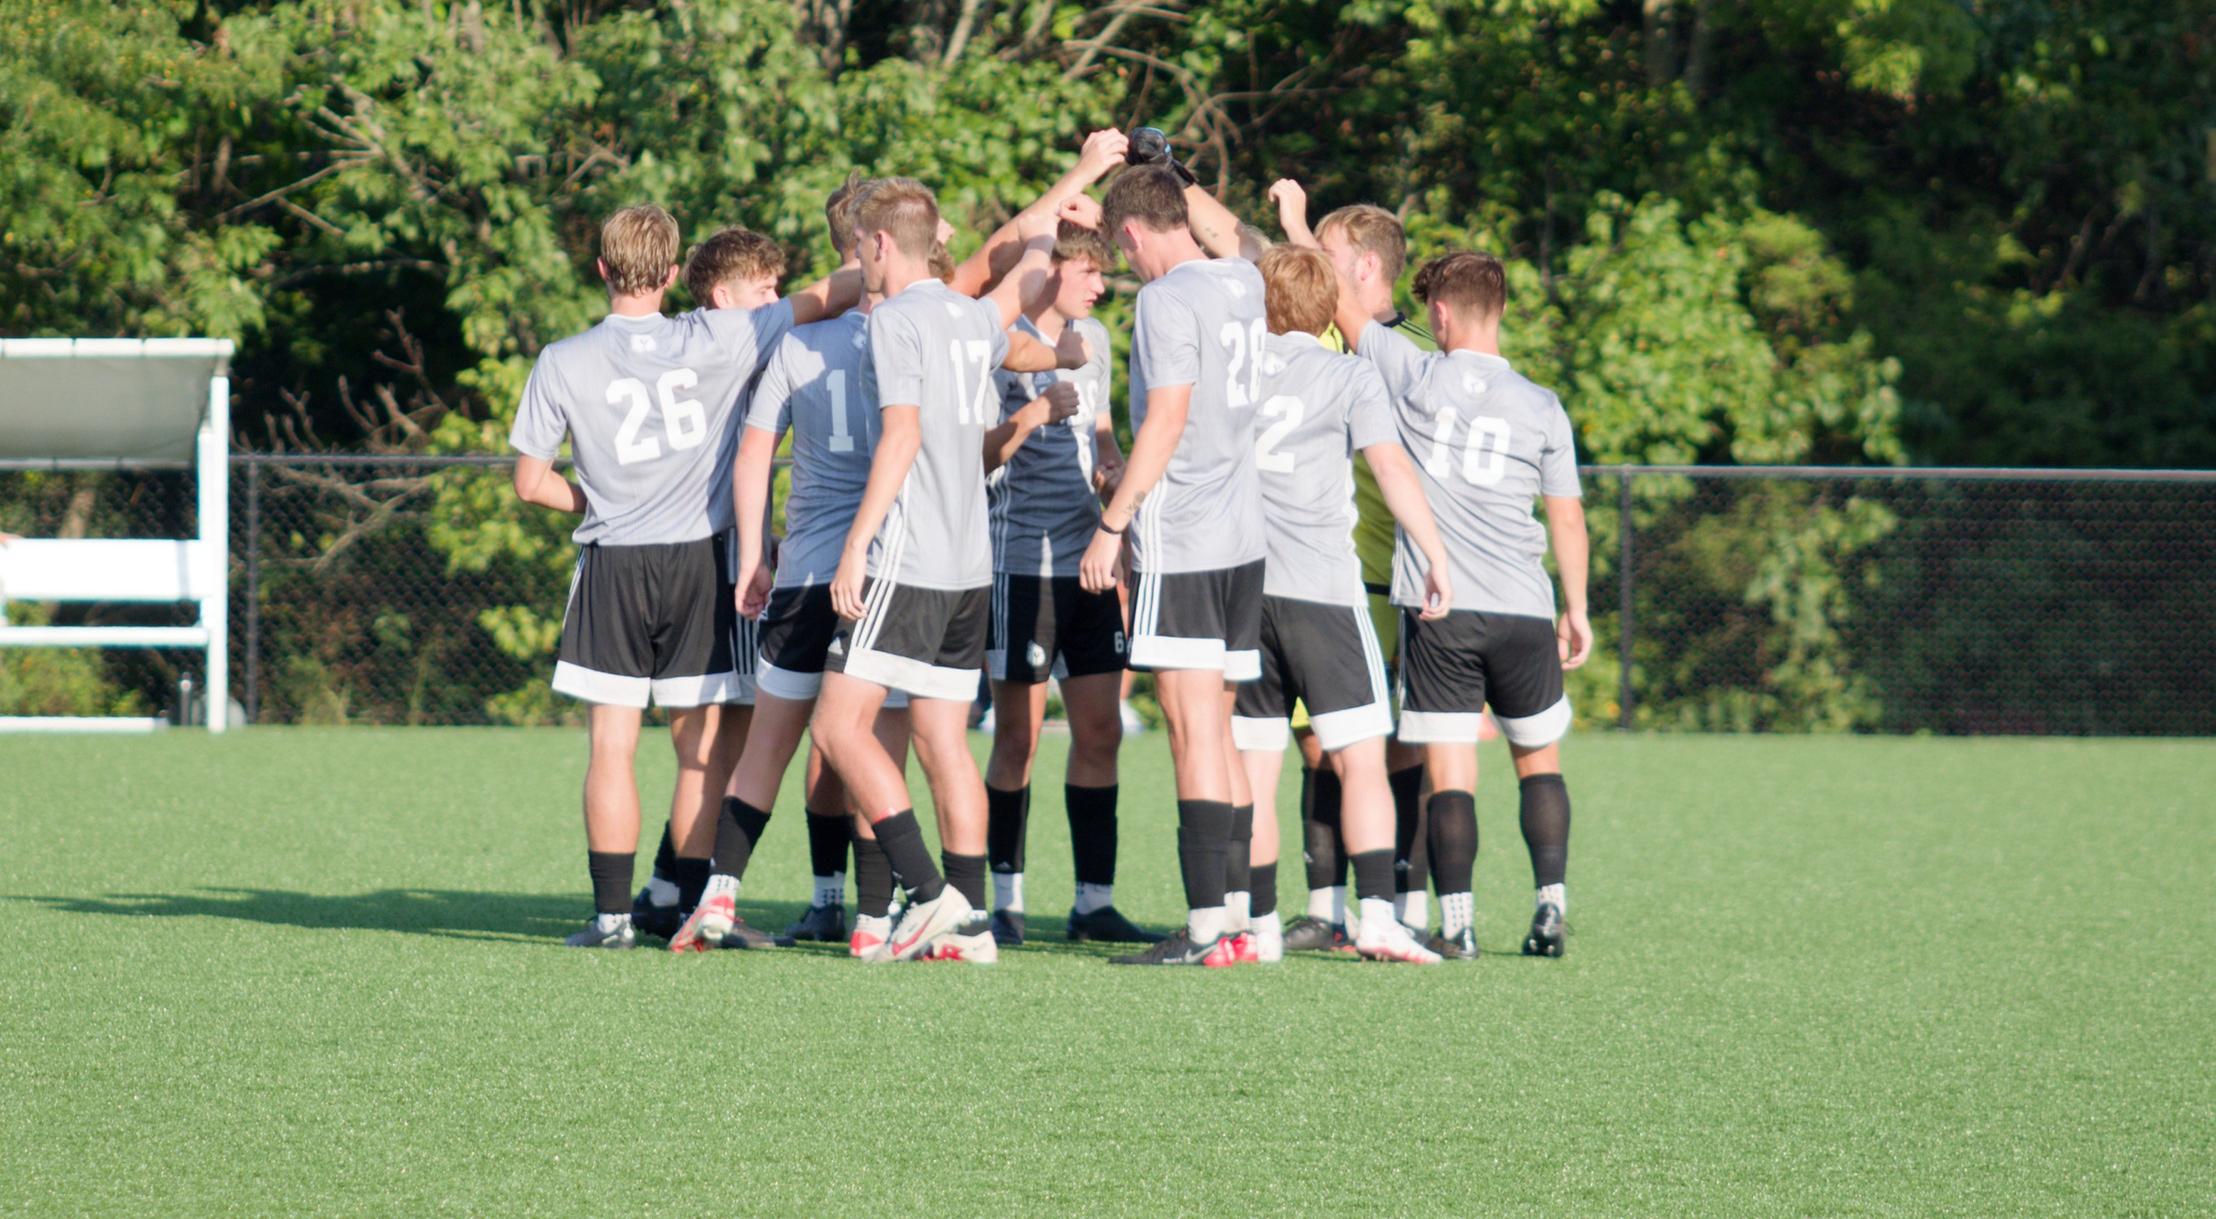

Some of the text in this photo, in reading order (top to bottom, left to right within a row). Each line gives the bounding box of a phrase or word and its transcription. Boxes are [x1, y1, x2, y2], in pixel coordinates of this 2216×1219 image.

[605, 367, 708, 466] 26
[826, 369, 854, 451] 1
[950, 339, 991, 424] 17
[1255, 394, 1304, 473] 2
[1425, 406, 1511, 486] 10
[1114, 631, 1124, 653] 6
